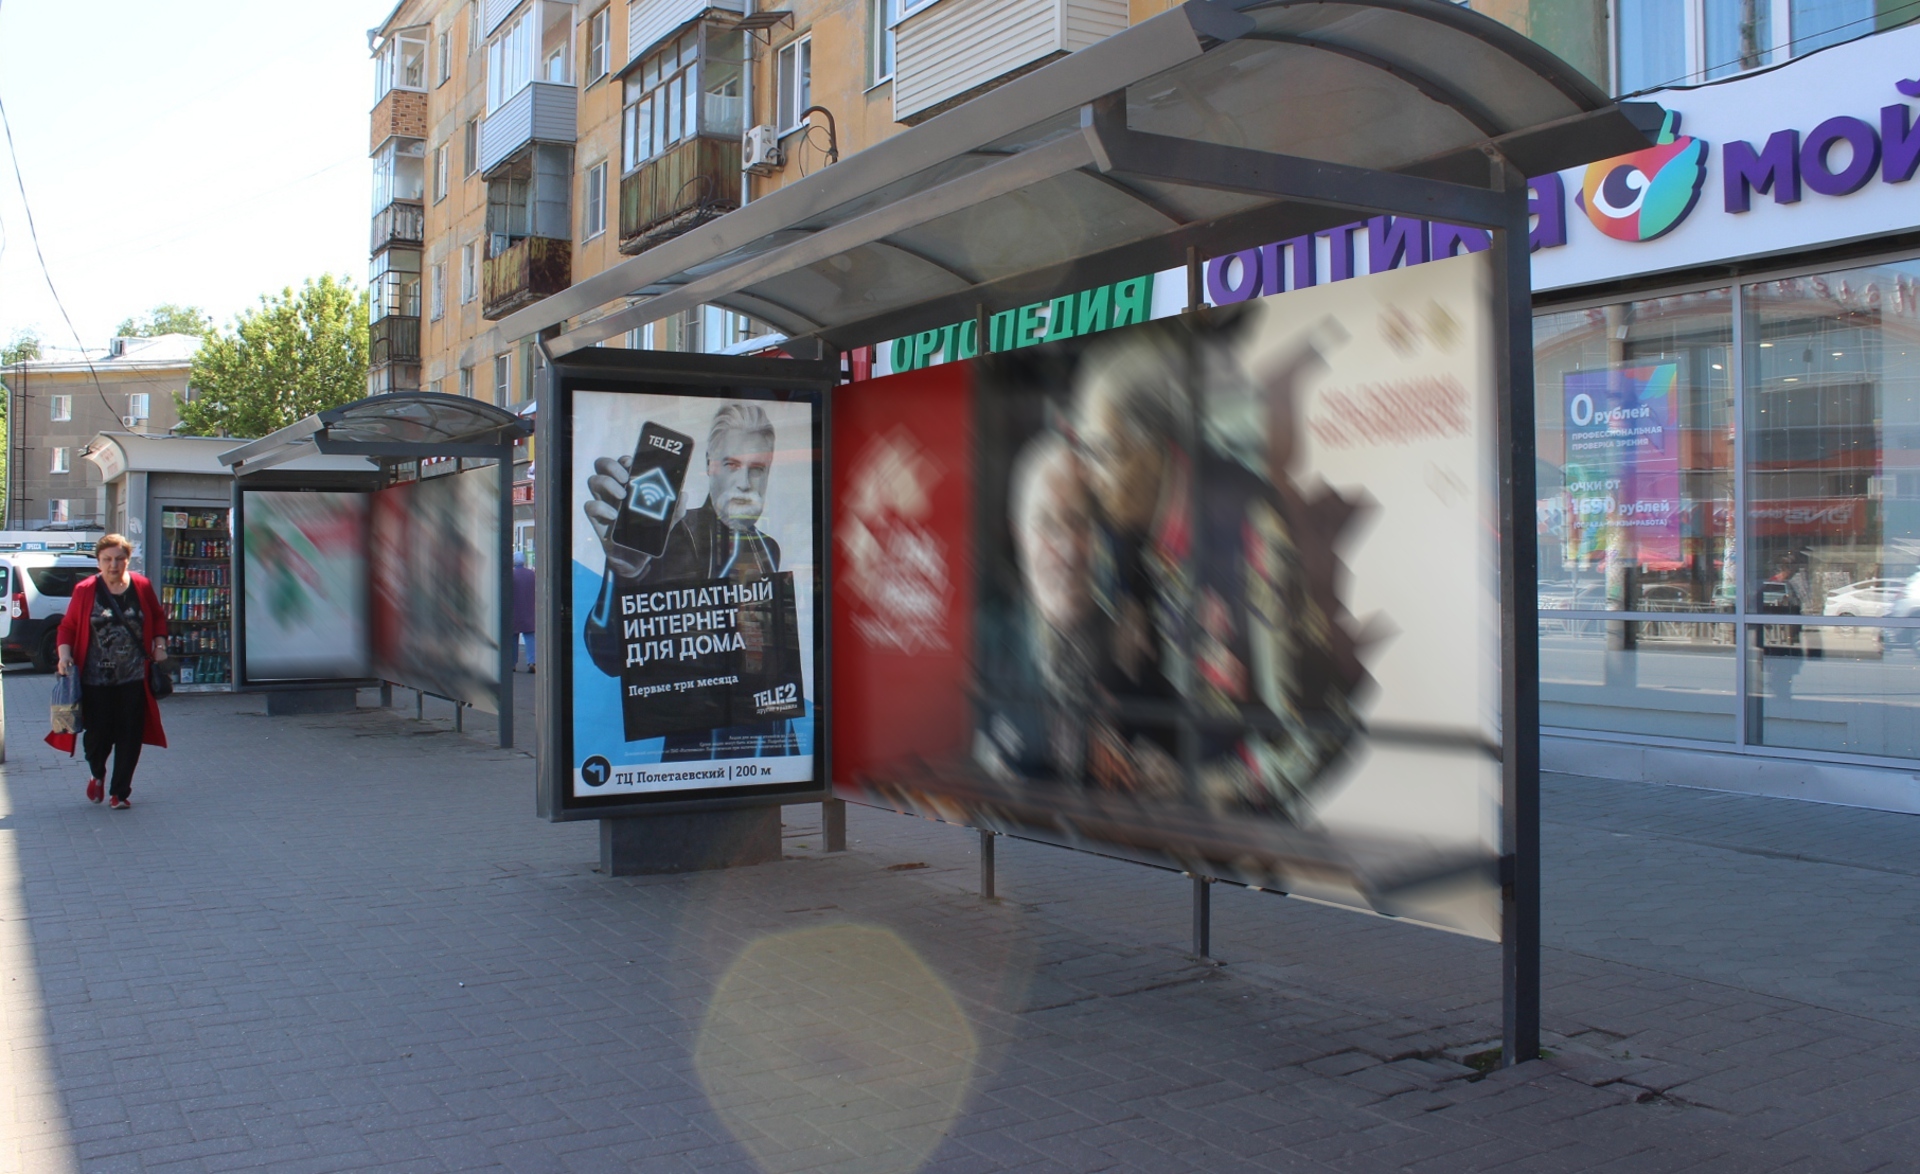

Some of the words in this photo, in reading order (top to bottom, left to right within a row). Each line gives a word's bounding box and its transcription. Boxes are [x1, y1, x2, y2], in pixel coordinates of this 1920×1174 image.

[890, 273, 1154, 374] ОРТОПЕДИЯ
[1571, 393, 1593, 426] 0
[1594, 404, 1650, 425] рублей
[649, 435, 684, 455] TELE2
[1572, 426, 1662, 440] ПРОФЕССИОНАЛЬНАЯ
[1572, 441, 1614, 451] ПРОВЕРКА
[1616, 438, 1649, 447] ЗРЕНИЯ
[1571, 497, 1616, 515] 1690
[1619, 499, 1669, 516] рублей
[622, 577, 773, 615] БЕСПЛАТНЫЙ
[624, 608, 738, 639] ИНТЕРНЕТ
[626, 639, 674, 668] ДЛЯ
[680, 632, 746, 661] ДОМА
[628, 684, 672, 697] Первые
[674, 681, 695, 693] три
[697, 675, 739, 688] месяца
[753, 682, 797, 708] TELE2
[615, 772, 633, 785] ТЦ
[636, 767, 725, 783] Полетаевский
[736, 765, 757, 778] 200
[760, 766, 772, 775] м
